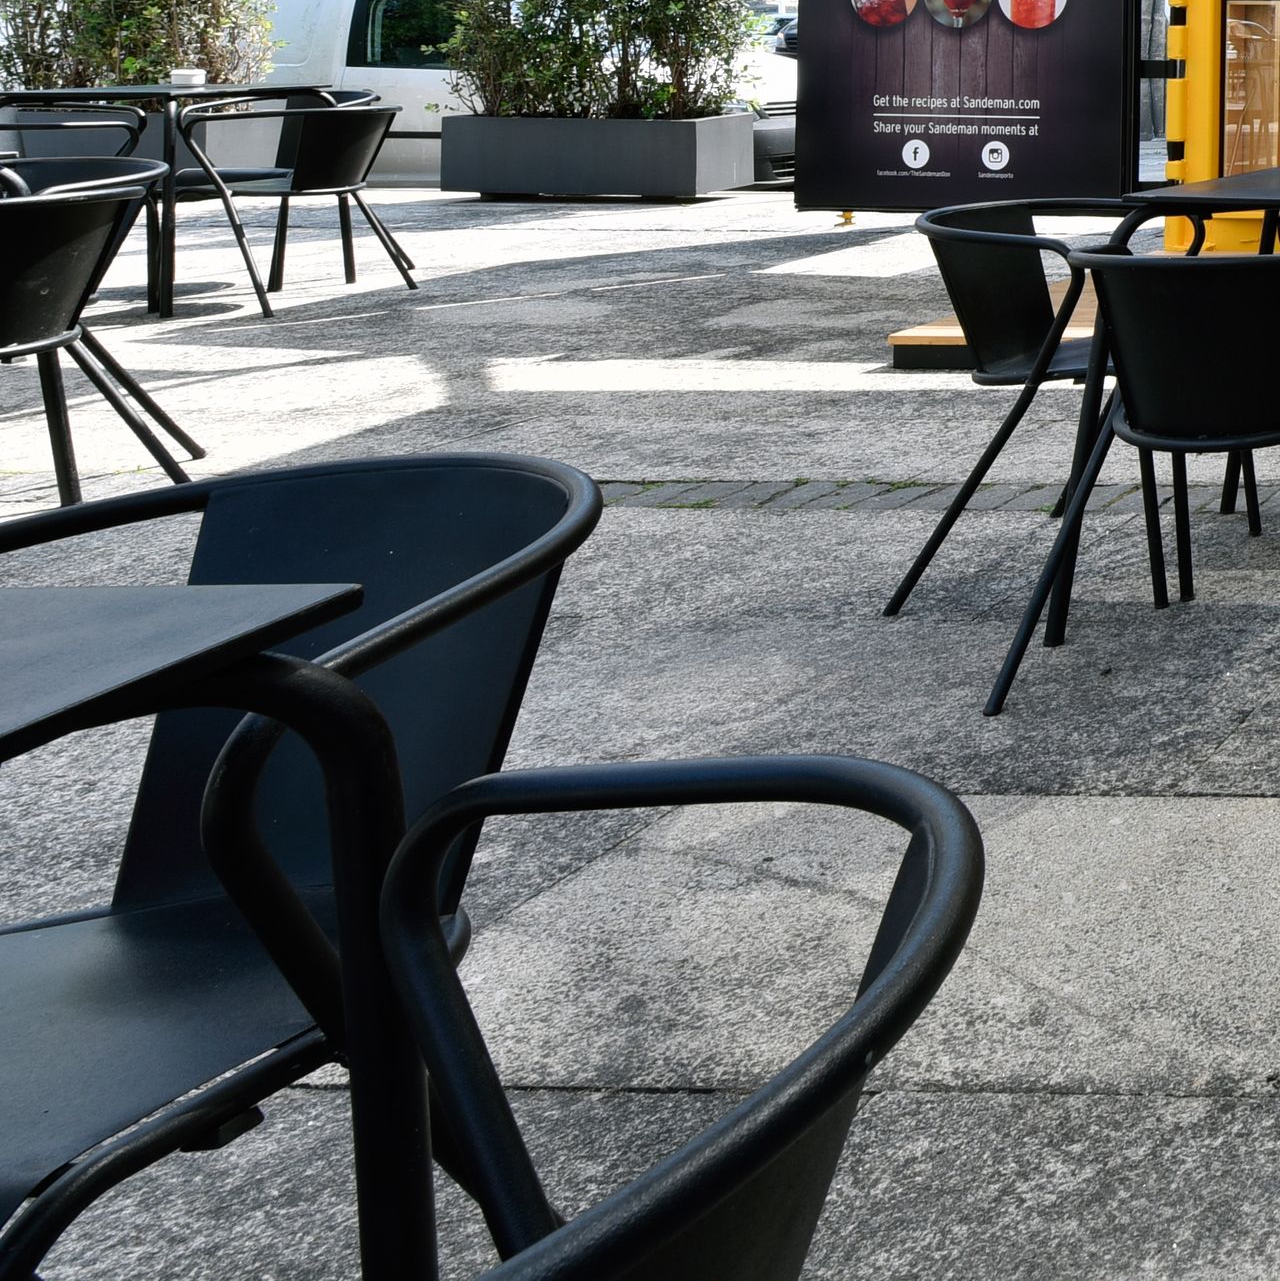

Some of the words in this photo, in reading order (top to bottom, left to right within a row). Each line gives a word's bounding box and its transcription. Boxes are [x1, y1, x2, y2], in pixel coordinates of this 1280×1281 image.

[873, 94, 890, 107] Get
[892, 95, 909, 107] the
[911, 95, 948, 110] recipes
[950, 96, 960, 108] at
[963, 95, 1040, 109] Sandeman.com
[873, 121, 901, 133] Share
[903, 123, 926, 136] your
[928, 122, 979, 135] Sandeman
[981, 123, 1026, 136] moments
[1028, 123, 1039, 136] at
